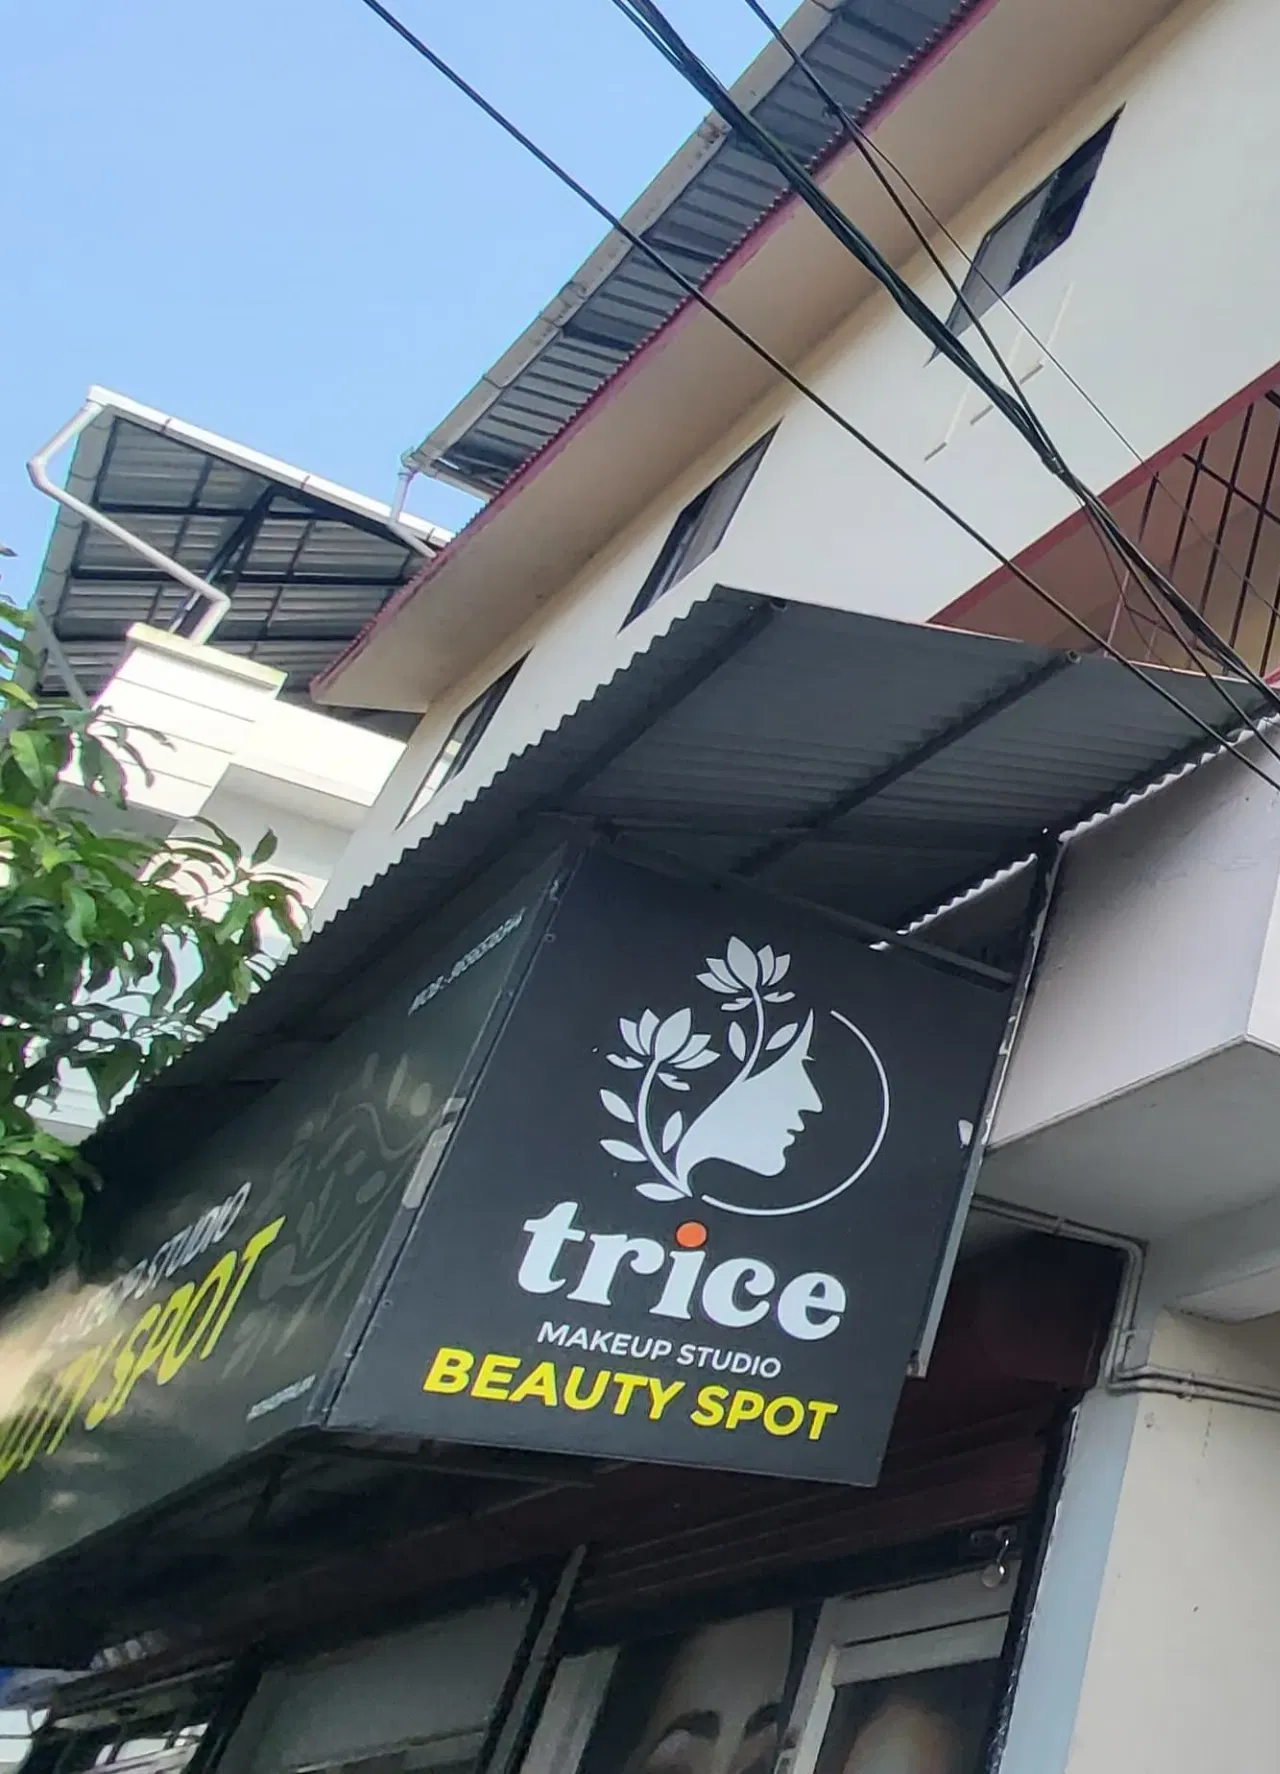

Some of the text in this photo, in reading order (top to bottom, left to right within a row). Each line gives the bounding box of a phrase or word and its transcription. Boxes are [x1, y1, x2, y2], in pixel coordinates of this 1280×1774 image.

[84, 1214, 287, 1432] SPOT
[516, 1200, 848, 1342] trice
[422, 1345, 840, 1441] BEAUTY SPOT
[536, 1320, 783, 1380] MAKEUP STUDIO
